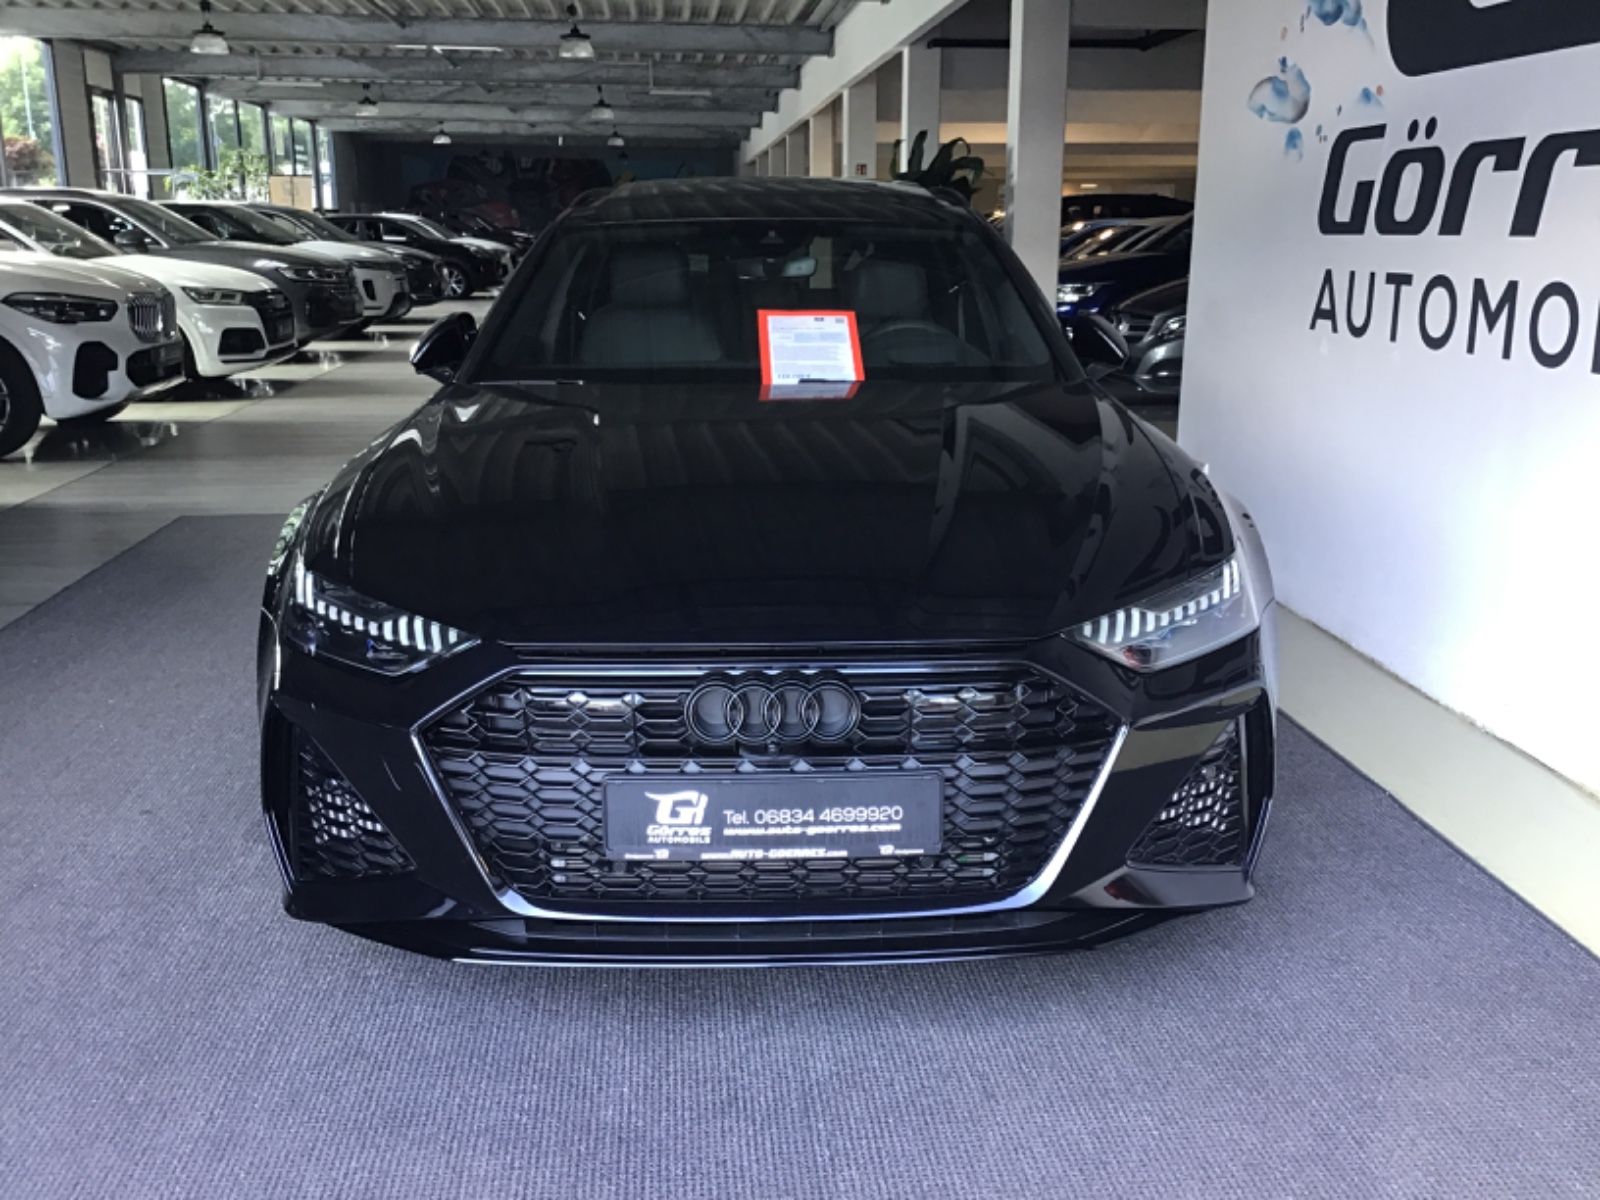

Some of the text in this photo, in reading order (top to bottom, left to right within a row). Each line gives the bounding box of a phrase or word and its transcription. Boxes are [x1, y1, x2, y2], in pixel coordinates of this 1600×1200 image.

[1309, 268, 1600, 374] AUTOMO
[722, 805, 903, 825] Tel. 06834 4699920
[647, 835, 711, 844] AUTOMOBILE
